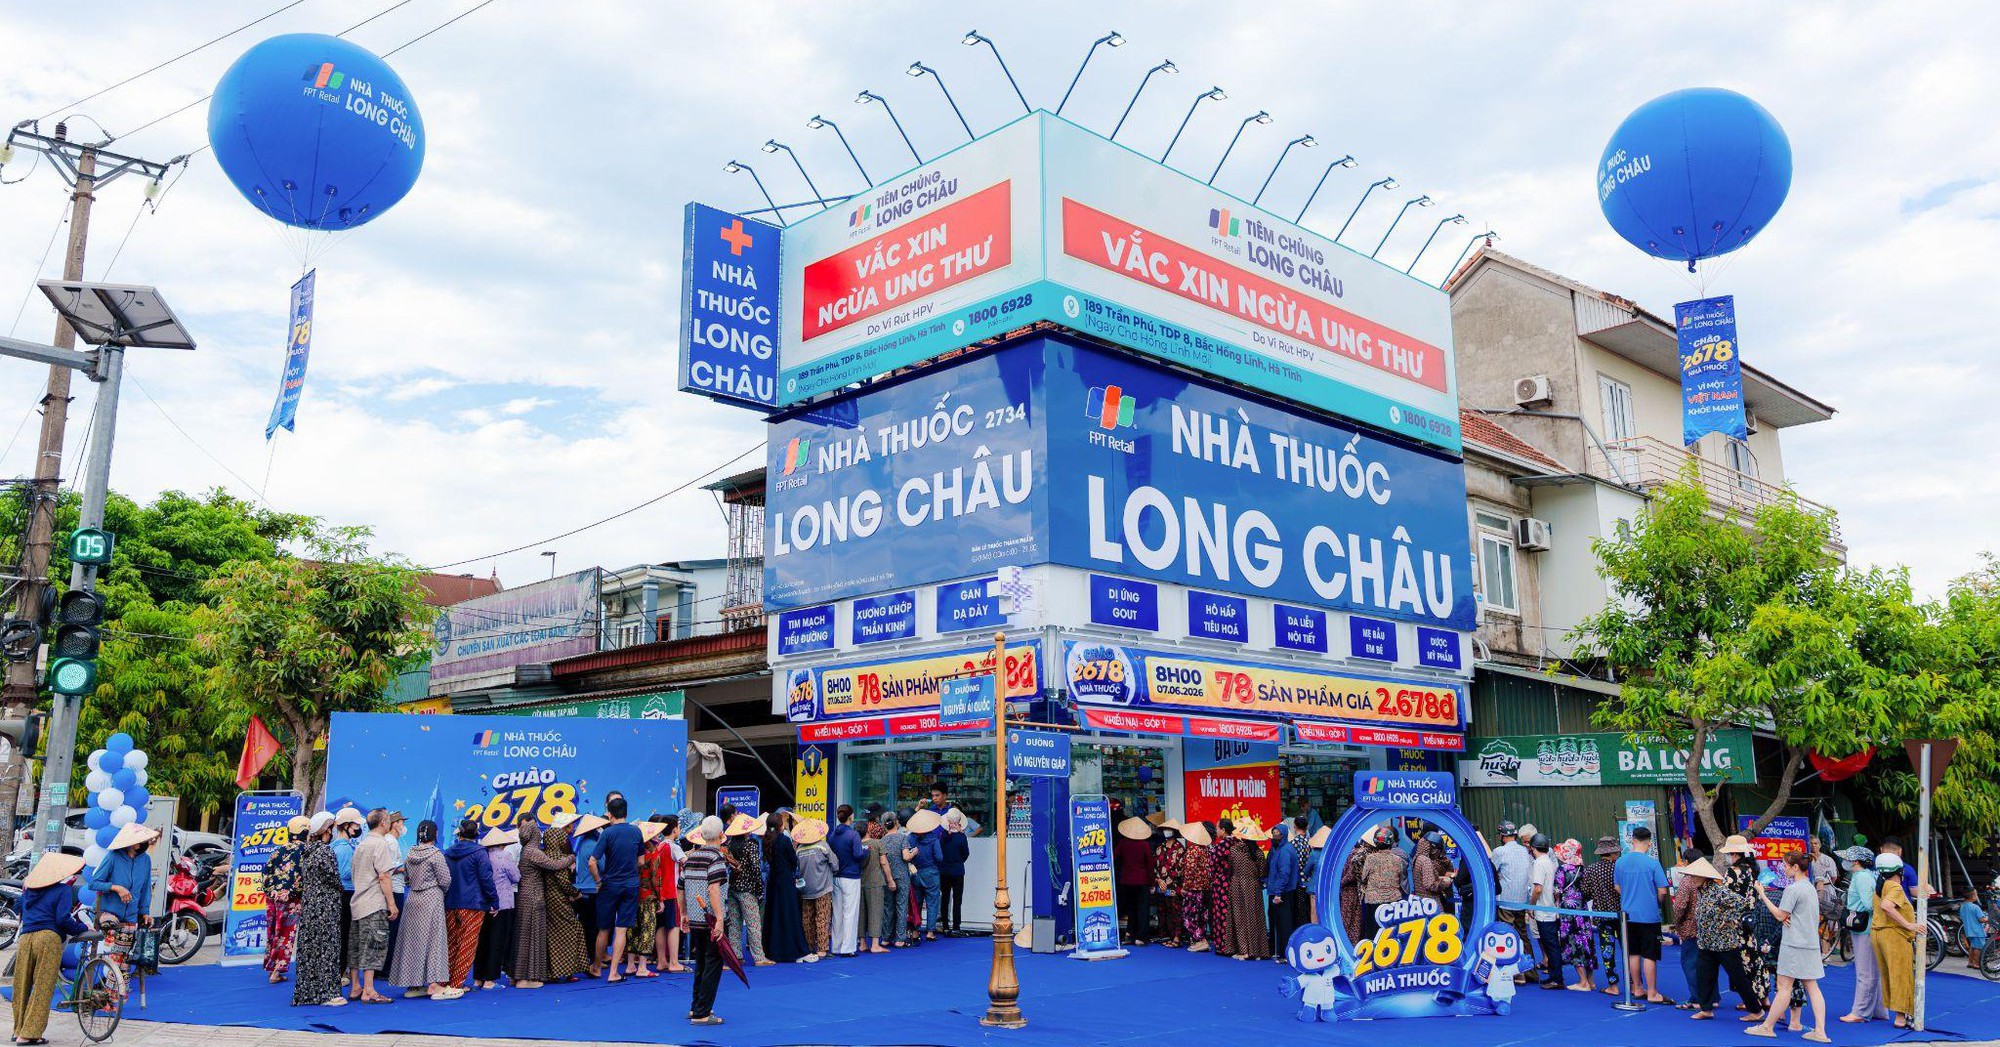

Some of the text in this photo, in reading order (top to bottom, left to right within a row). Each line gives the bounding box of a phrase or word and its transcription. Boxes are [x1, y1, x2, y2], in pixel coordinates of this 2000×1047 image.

[303, 86, 341, 104] FPT Retail
[350, 77, 408, 119] NHÀ THUỐC
[345, 93, 416, 150] LONG CHÂU
[1617, 154, 1651, 184] CHÂU
[876, 170, 941, 208] TIÊM CHỦNG
[876, 177, 958, 228] LONG CHÂU
[854, 222, 948, 280] VẮC XIN
[1246, 219, 1324, 266] TIÊM CHỦNG
[712, 260, 758, 291] NHÀ
[1247, 241, 1344, 299] LONG CHÂU
[817, 234, 994, 328] NGỪA UNG THƯ
[698, 289, 771, 325] THUỐC
[968, 306, 998, 325] 1800
[1001, 293, 1033, 314] 6928
[1101, 229, 1424, 380] VẮC XIN NGỪA UNG THƯ
[1695, 319, 1713, 329] LONG
[693, 318, 773, 360] LONG
[1083, 298, 1102, 315] 189
[1105, 305, 1130, 325] Trần
[1133, 314, 1157, 336] Phú,
[1159, 324, 1181, 341] TDP
[1183, 333, 1193, 347] 8,
[1195, 336, 1214, 353] Bắc
[1216, 343, 1242, 363] Hồng
[1268, 361, 1280, 375] Hà
[1253, 331, 1266, 345] Do
[1278, 340, 1294, 355] Rút
[1296, 347, 1315, 362] HPV
[1684, 340, 1733, 371] 2678
[691, 361, 773, 401] CHÂU
[818, 391, 1026, 474] NHÀ THUỐC 2734
[1403, 409, 1427, 429] 1800
[1429, 418, 1453, 438] 6928
[1089, 430, 1135, 454] FPT Retail
[1171, 405, 1392, 506] NHÀ THUỐC
[775, 474, 808, 493] FPT Retail
[773, 444, 1033, 557] LONG CHÂU
[77, 536, 103, 557] 05
[1088, 474, 1453, 619] LONG CHÂU
[960, 587, 981, 601] GAN
[1108, 587, 1140, 603] DỊ ỨNG
[856, 600, 913, 620] XƯƠNG KHỚP
[953, 603, 989, 622] DẠ DÀY
[1112, 607, 1137, 621] GOUT
[1205, 603, 1236, 619] HÔ HẤP
[788, 615, 825, 630] TIM MẠCH
[862, 620, 906, 637] THẦN KINH
[1203, 620, 1220, 634] TIÊU
[1288, 616, 1299, 627] DA
[1288, 631, 1316, 645] NỘI TIẾT
[1365, 643, 1375, 654] EM
[1073, 660, 1124, 683] 2678
[1155, 665, 1202, 686] 8H00
[827, 677, 851, 694] 8H00
[858, 673, 881, 705] 78
[882, 673, 904, 699] SẢN
[907, 670, 939, 697] PHẨM
[955, 684, 980, 695] ĐƯỜNG
[1080, 683, 1121, 694] NHÀ THUỐC
[1156, 685, 1204, 697] 07.06.2026
[1214, 670, 1455, 721] 78 SẢN PHẨM GIÁ 2.678đ
[973, 696, 990, 712] QUỐC
[920, 718, 937, 729] 1800
[1144, 715, 1160, 728] GÓP
[1219, 724, 1235, 735] 1800
[1236, 726, 1253, 736] 6928
[504, 729, 561, 742] NHÀ THUỐC
[1026, 737, 1054, 748] ĐƯỜNG
[504, 743, 577, 758] LONG CHÂU
[1618, 746, 1731, 771] BÀ LONG
[807, 752, 816, 773] 1
[1013, 753, 1067, 770] VÕ NGUYÊN GIÁP
[492, 766, 556, 789] CHÀO
[1200, 772, 1219, 797] VẮC
[1237, 775, 1266, 798] PHÒNG
[1388, 776, 1437, 789] NHÀ THUỐC
[805, 784, 817, 797] ĐỦ
[1388, 790, 1451, 804] LONG CHÂU
[279, 808, 298, 816] CHÂU
[464, 782, 577, 828] 2678
[798, 799, 825, 812] THUỐC
[255, 820, 281, 830] CHÀO
[241, 826, 289, 849] 2678
[1078, 829, 1106, 850] 2678
[1767, 842, 1802, 857] 25%
[240, 864, 262, 872] 8H00
[238, 876, 252, 887] 78
[1080, 876, 1089, 884] 78
[1080, 889, 1111, 902] 2.678đ
[1376, 895, 1438, 923] CHÀO
[1354, 913, 1463, 978] 2678
[1366, 968, 1451, 994] NHÀ THUỐC
